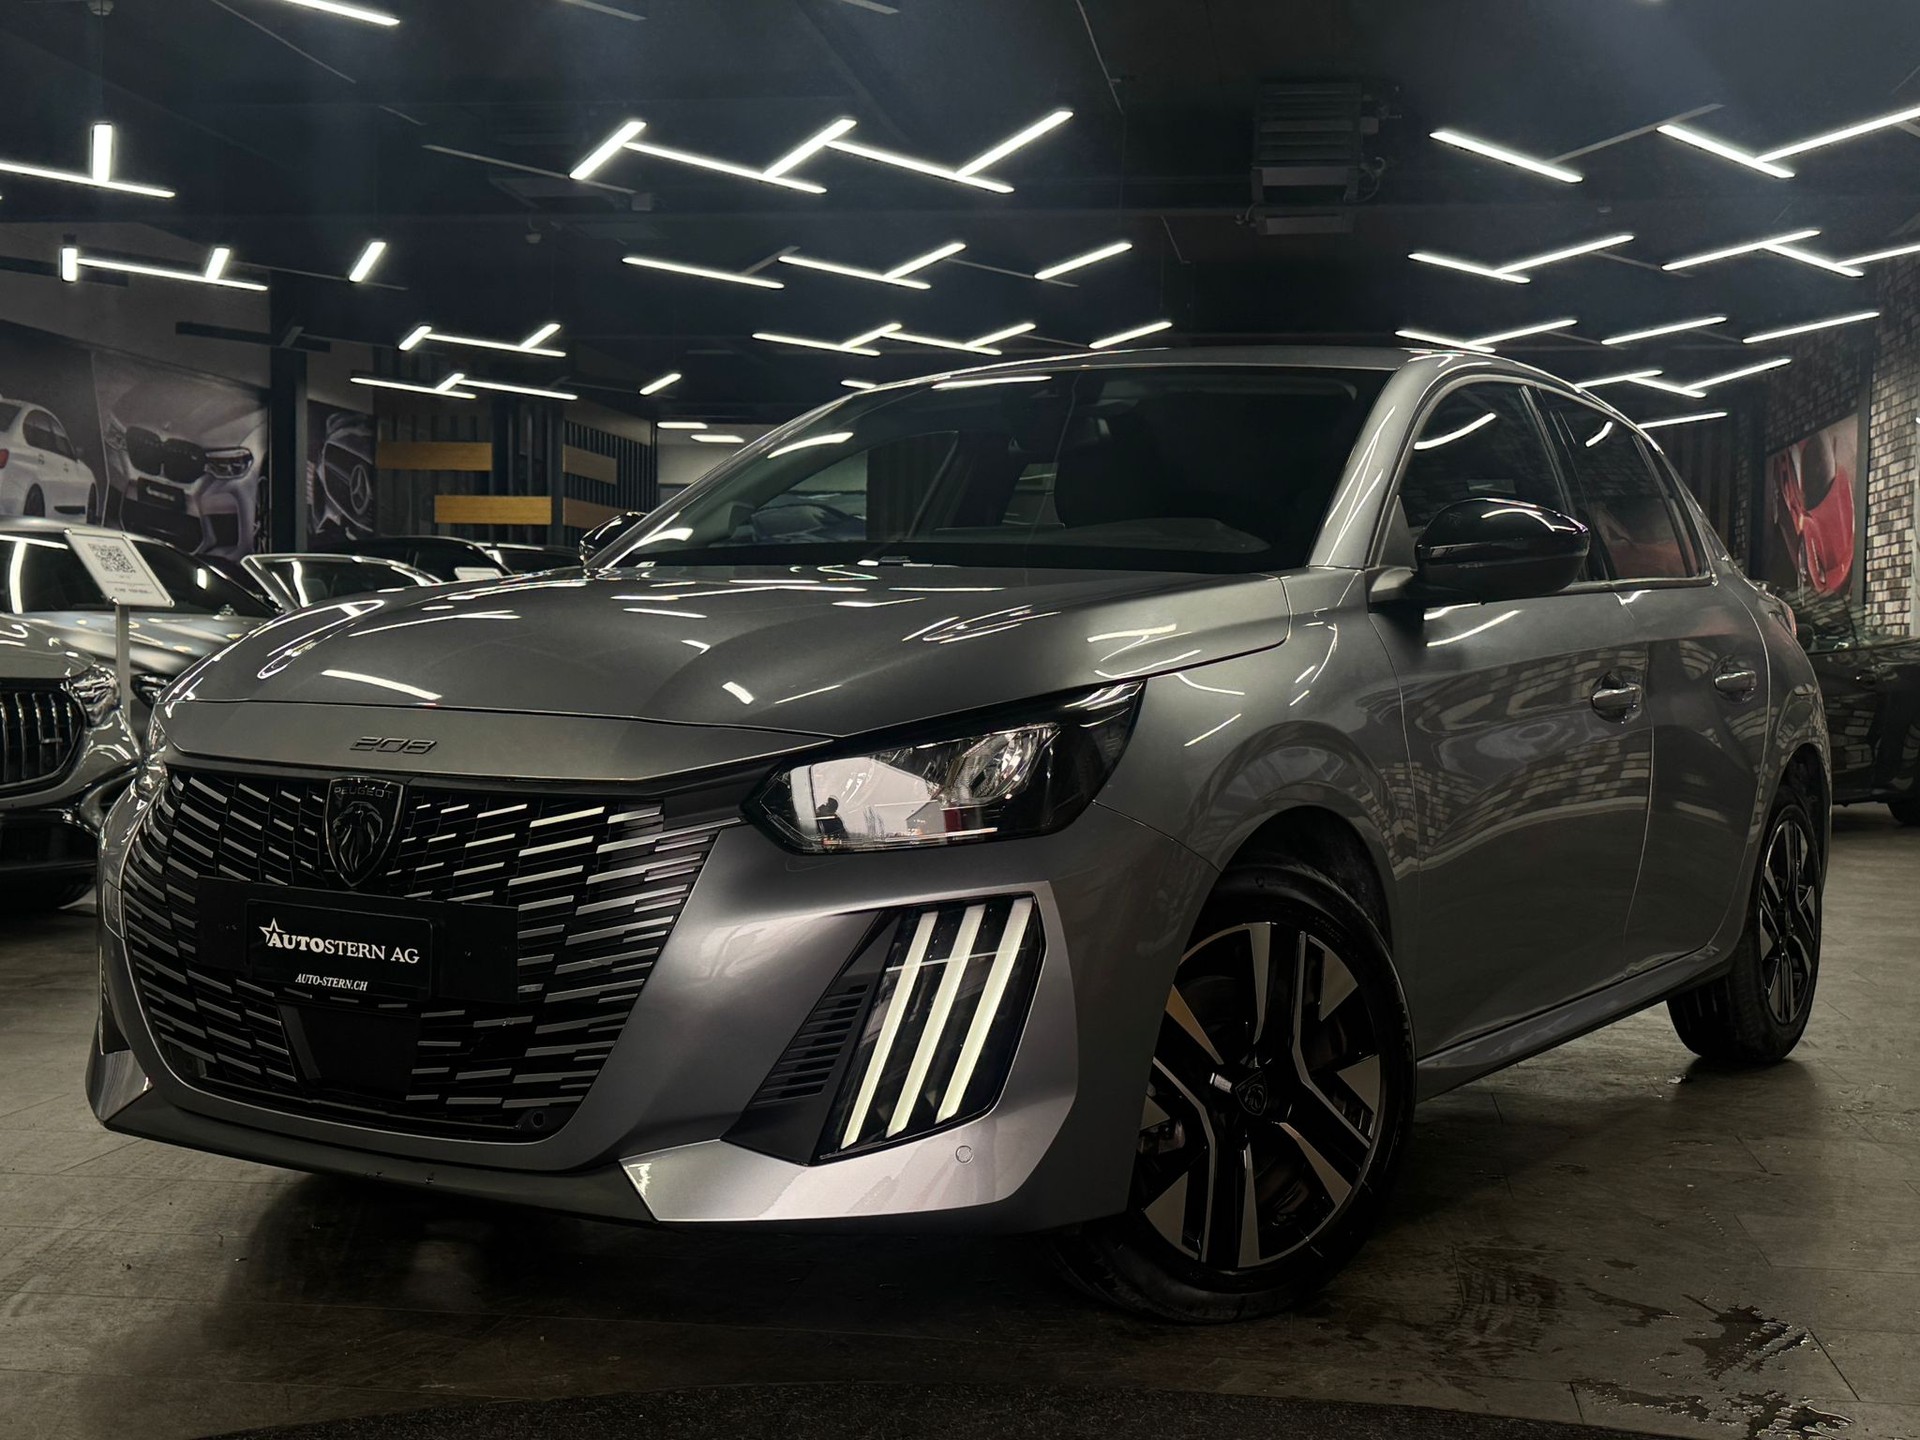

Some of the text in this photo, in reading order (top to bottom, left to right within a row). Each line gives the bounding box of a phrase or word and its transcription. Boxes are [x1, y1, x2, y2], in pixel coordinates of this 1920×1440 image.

[350, 736, 437, 754] 208
[334, 786, 393, 798] PEUGEOT
[268, 932, 420, 964] AUTOSTERN AG
[295, 973, 368, 991] AUTO-STERN.CH
